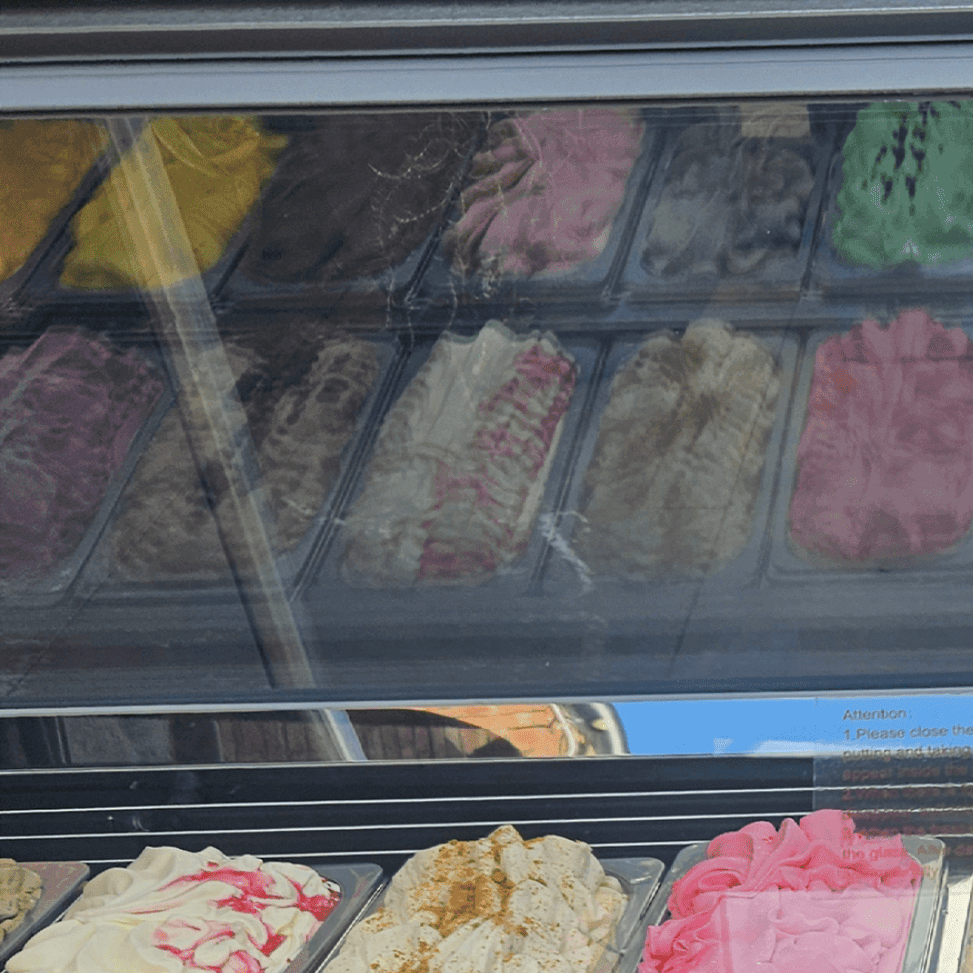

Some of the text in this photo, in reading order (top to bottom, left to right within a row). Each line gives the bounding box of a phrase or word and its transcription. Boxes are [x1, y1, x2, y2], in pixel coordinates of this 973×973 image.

[843, 727, 906, 740] 1.Please
[909, 726, 949, 738] close
[842, 749, 892, 763] putting
[896, 745, 923, 758] and
[927, 745, 971, 759] taking
